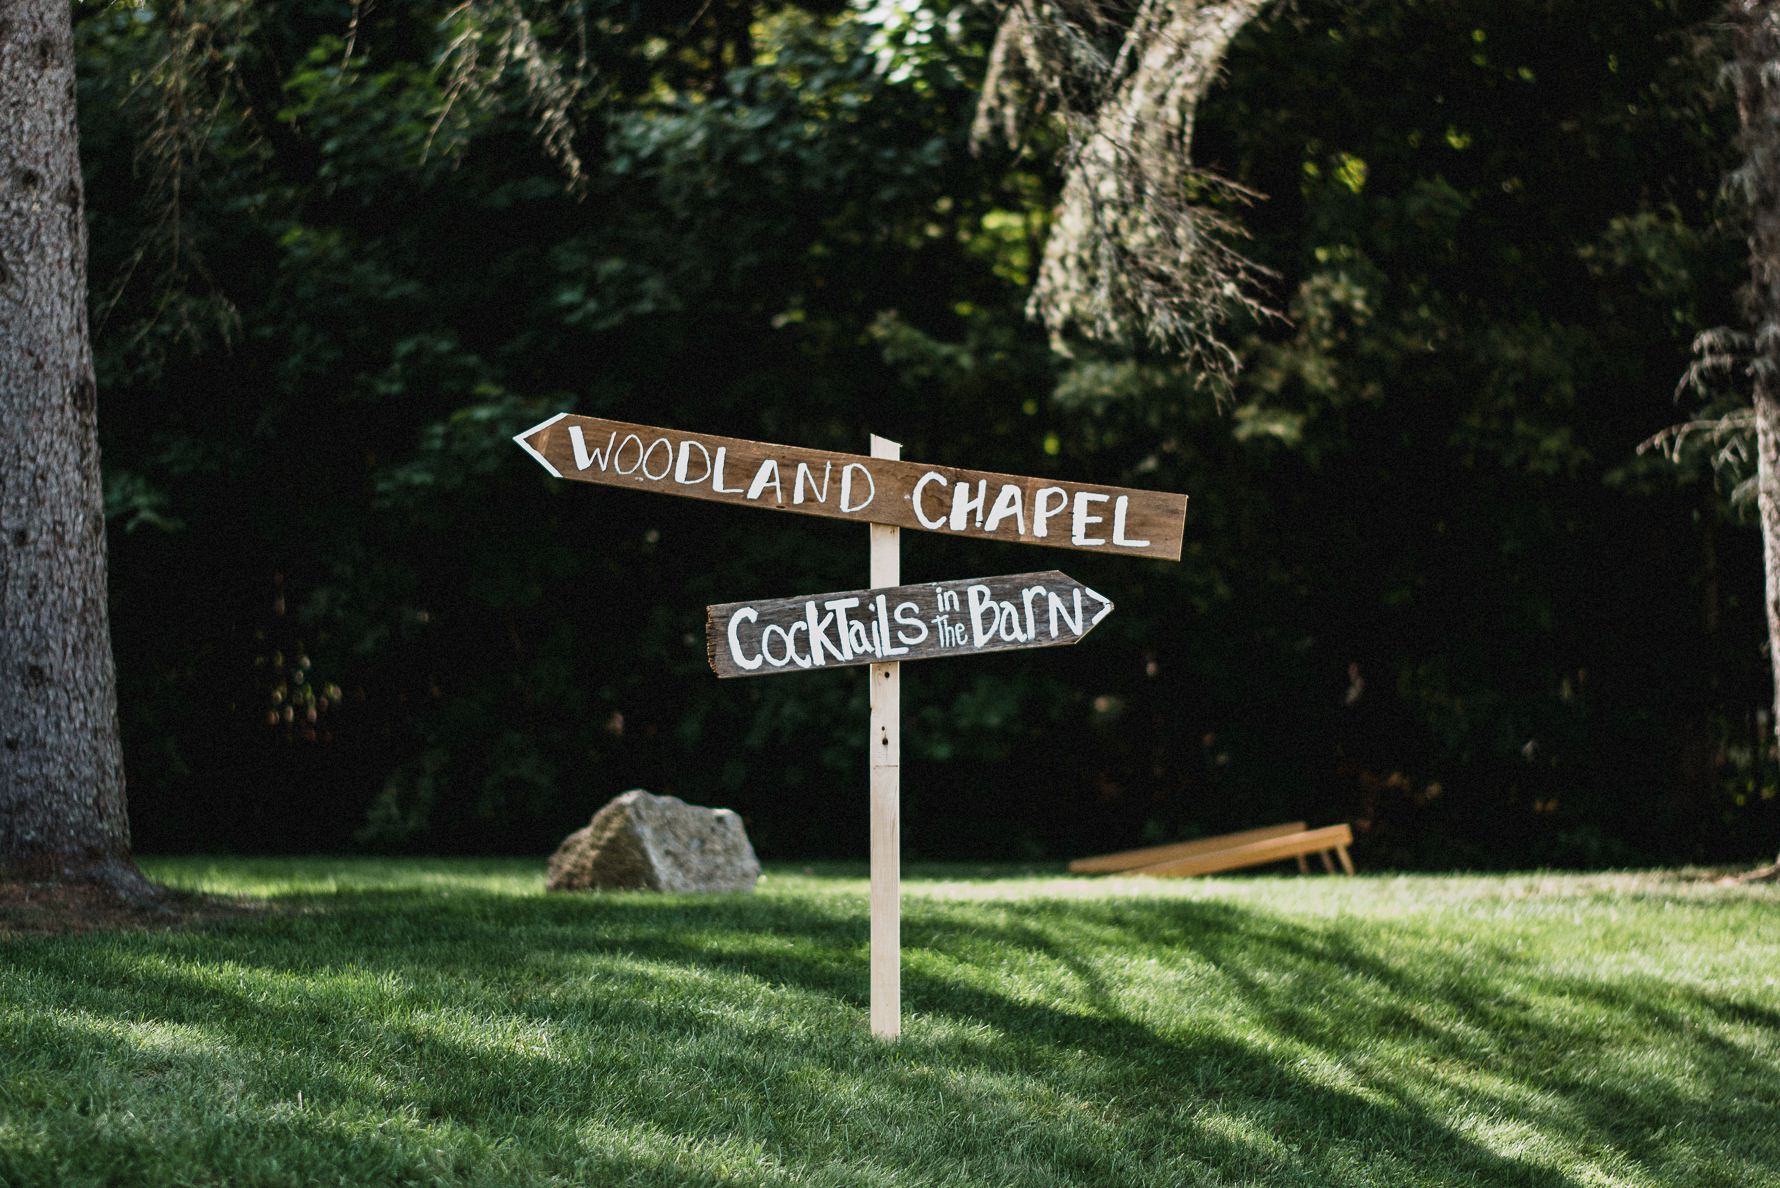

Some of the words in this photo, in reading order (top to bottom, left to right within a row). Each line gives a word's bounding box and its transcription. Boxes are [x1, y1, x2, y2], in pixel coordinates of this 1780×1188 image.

[568, 426, 875, 513] WOODLAND
[912, 471, 1151, 547] CHAPEL
[936, 585, 960, 612] in
